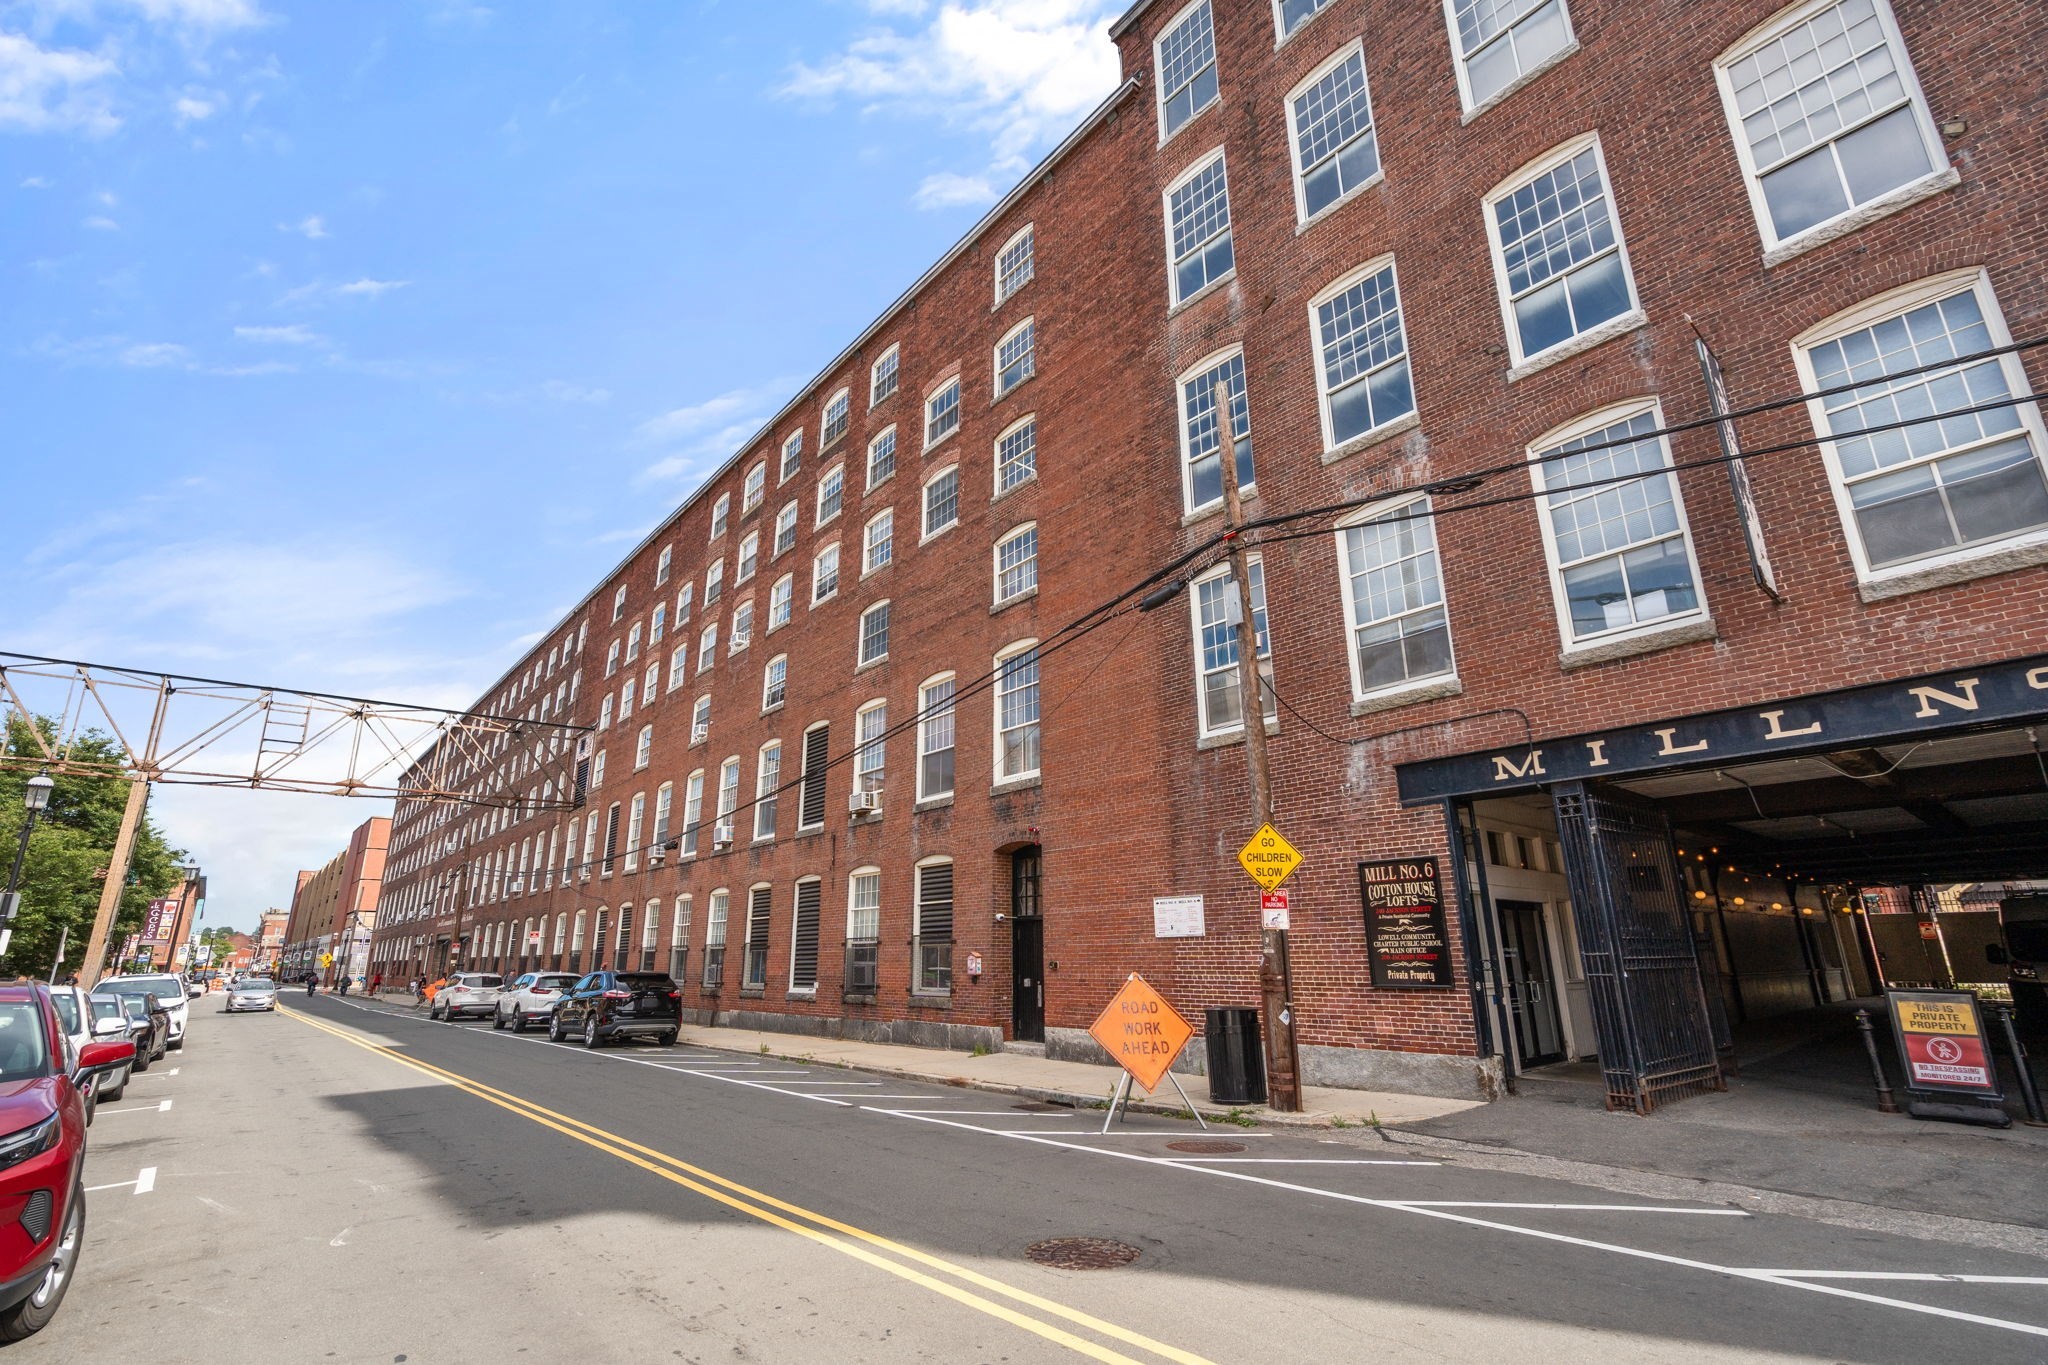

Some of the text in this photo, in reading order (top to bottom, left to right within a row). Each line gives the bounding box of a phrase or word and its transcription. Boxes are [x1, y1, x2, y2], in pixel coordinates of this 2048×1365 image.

[1491, 710, 1822, 781] MILL
[1261, 837, 1275, 847] GO
[1246, 852, 1292, 863] CHILDREN
[1255, 867, 1282, 877] SLOW
[1364, 862, 1435, 882] MILL NO. 6
[1368, 881, 1436, 901] COTTON HOUSE
[1386, 895, 1420, 907] LOFTS
[1387, 969, 1436, 982] Private Property
[1121, 1001, 1158, 1014] ROAD
[1916, 1004, 1954, 1013] THIS IS
[1912, 1012, 1960, 1022] PRIVATE
[1123, 1022, 1162, 1035] WORK
[1909, 1020, 1967, 1031] PROPERTY
[1121, 1040, 1170, 1055] AHEAD
[1931, 1064, 1980, 1074] TRESPASSING
[1920, 1073, 1961, 1081] MONITORED
